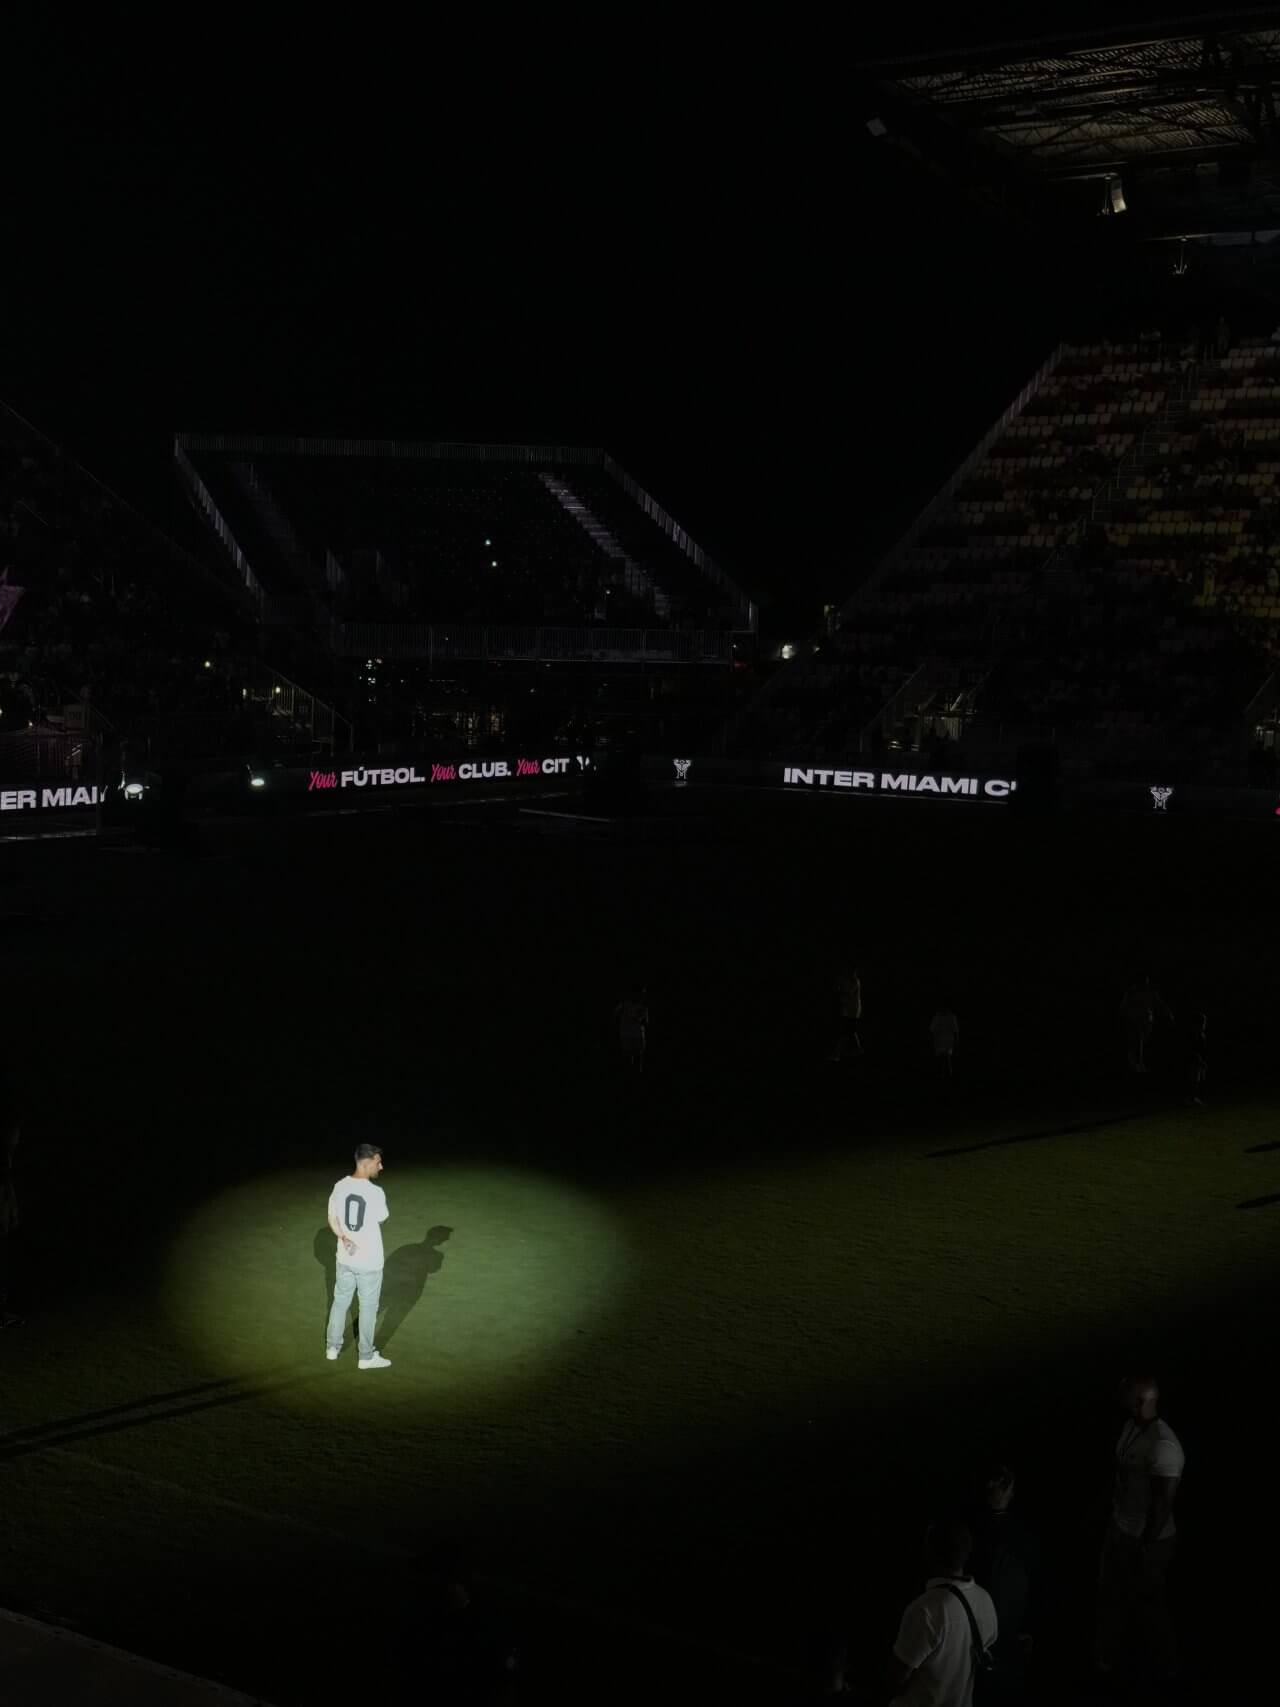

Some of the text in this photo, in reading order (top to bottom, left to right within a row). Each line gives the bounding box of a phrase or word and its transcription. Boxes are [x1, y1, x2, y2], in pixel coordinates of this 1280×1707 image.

[309, 770, 338, 791] Your
[340, 766, 425, 788] FÚTBOL.
[430, 763, 457, 783] Your
[458, 761, 512, 779] CLUB.
[516, 758, 540, 777] Your
[783, 767, 875, 788] INTER
[880, 773, 978, 795] MIAMI
